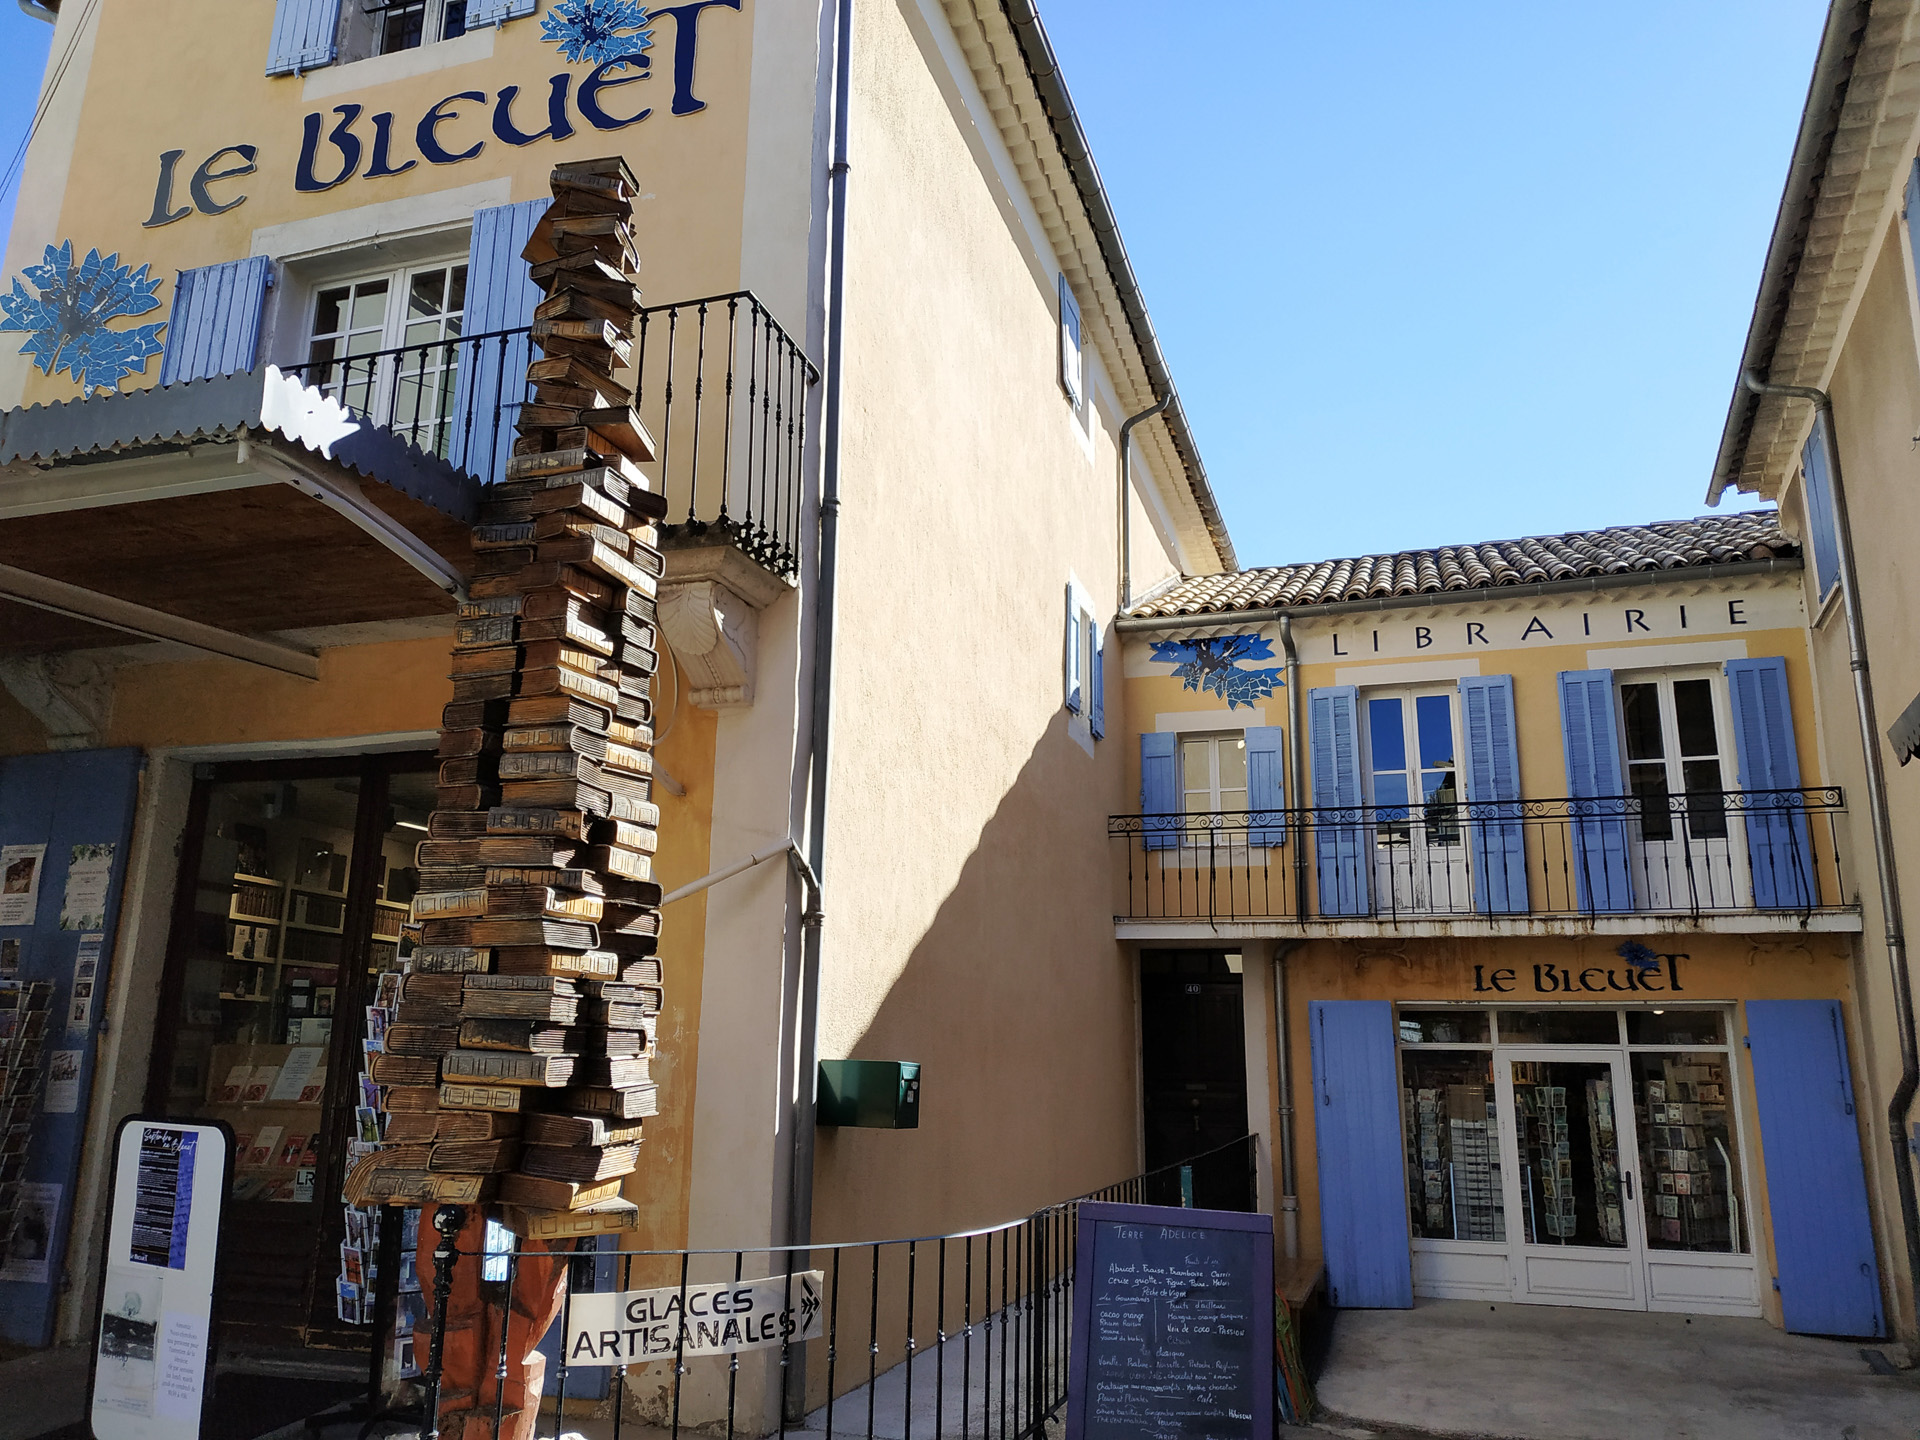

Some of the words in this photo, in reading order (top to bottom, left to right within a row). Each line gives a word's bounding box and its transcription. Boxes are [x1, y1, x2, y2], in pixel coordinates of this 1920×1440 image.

[1332, 599, 1748, 657] LIBRAIRIE
[1187, 985, 1199, 993] 40
[1160, 1227, 1207, 1240] ADELICE
[625, 1287, 755, 1324] GLACES
[571, 1306, 797, 1360] ARTISANALES
